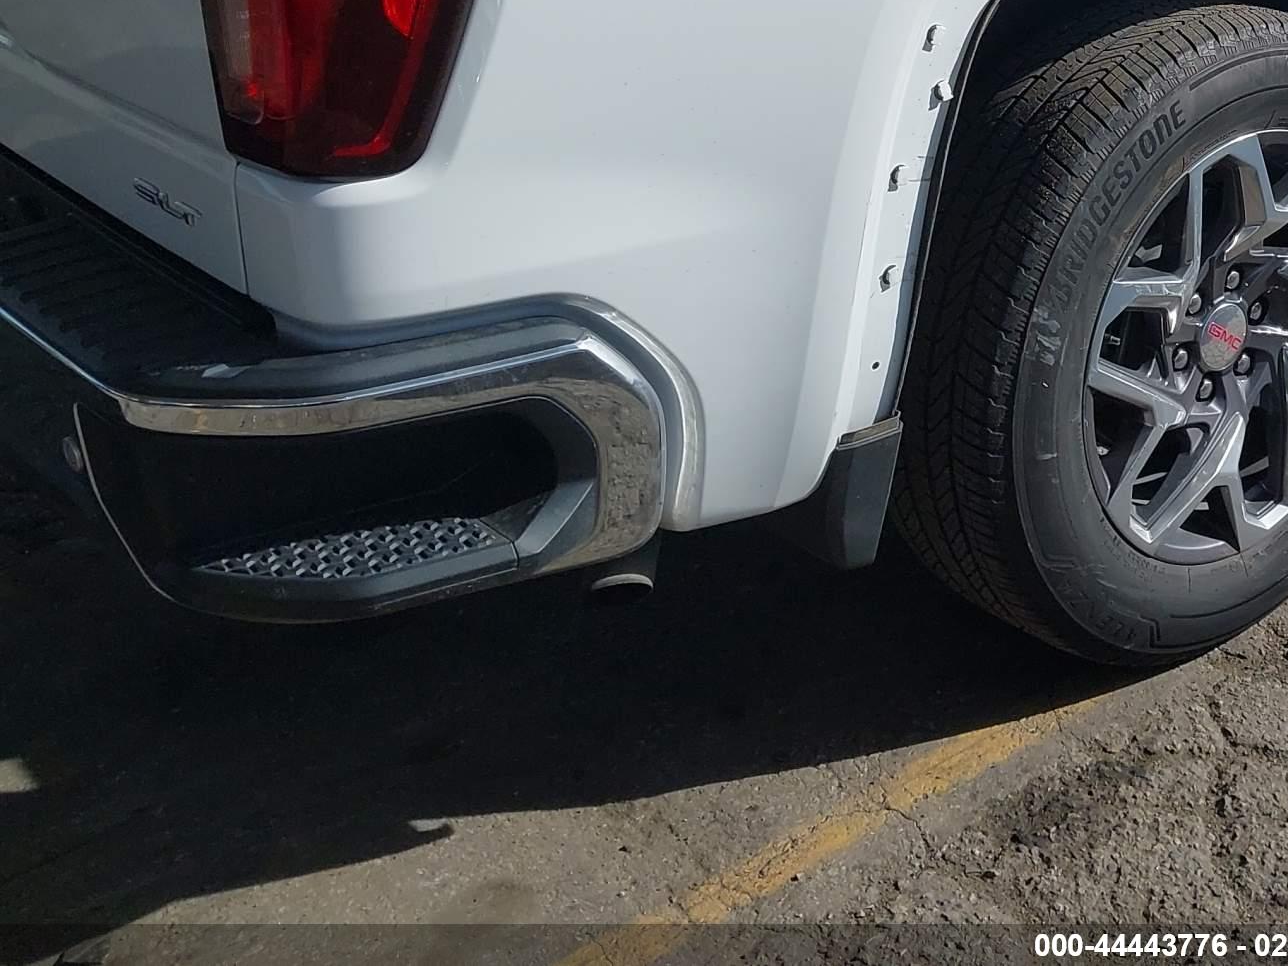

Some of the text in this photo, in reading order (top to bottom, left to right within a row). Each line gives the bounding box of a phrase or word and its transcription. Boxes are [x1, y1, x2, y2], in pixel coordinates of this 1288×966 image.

[133, 178, 203, 227] SLT
[1053, 99, 1187, 310] BRIDGESTONE
[1208, 322, 1242, 351] GMC
